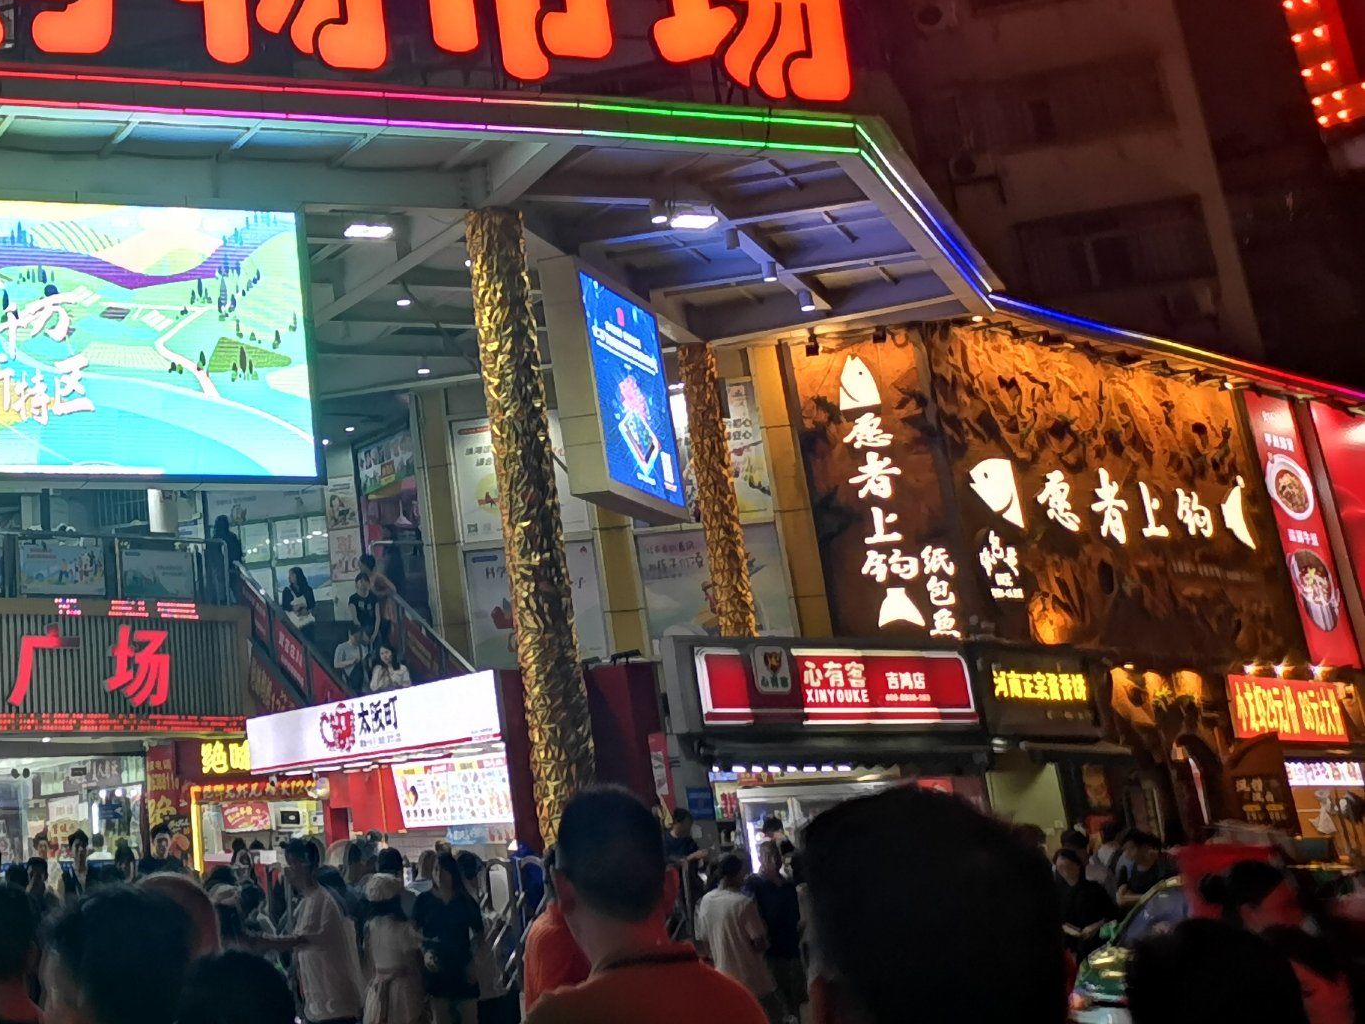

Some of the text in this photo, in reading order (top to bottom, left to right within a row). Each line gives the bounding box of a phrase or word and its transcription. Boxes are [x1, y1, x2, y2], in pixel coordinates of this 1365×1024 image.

[843, 412, 918, 582] 愿者上钩
[1036, 467, 1213, 545] 愿者上钩
[920, 545, 961, 638] 纸包鱼
[804, 660, 866, 688] 心有客
[806, 689, 870, 703] XINYOUKE
